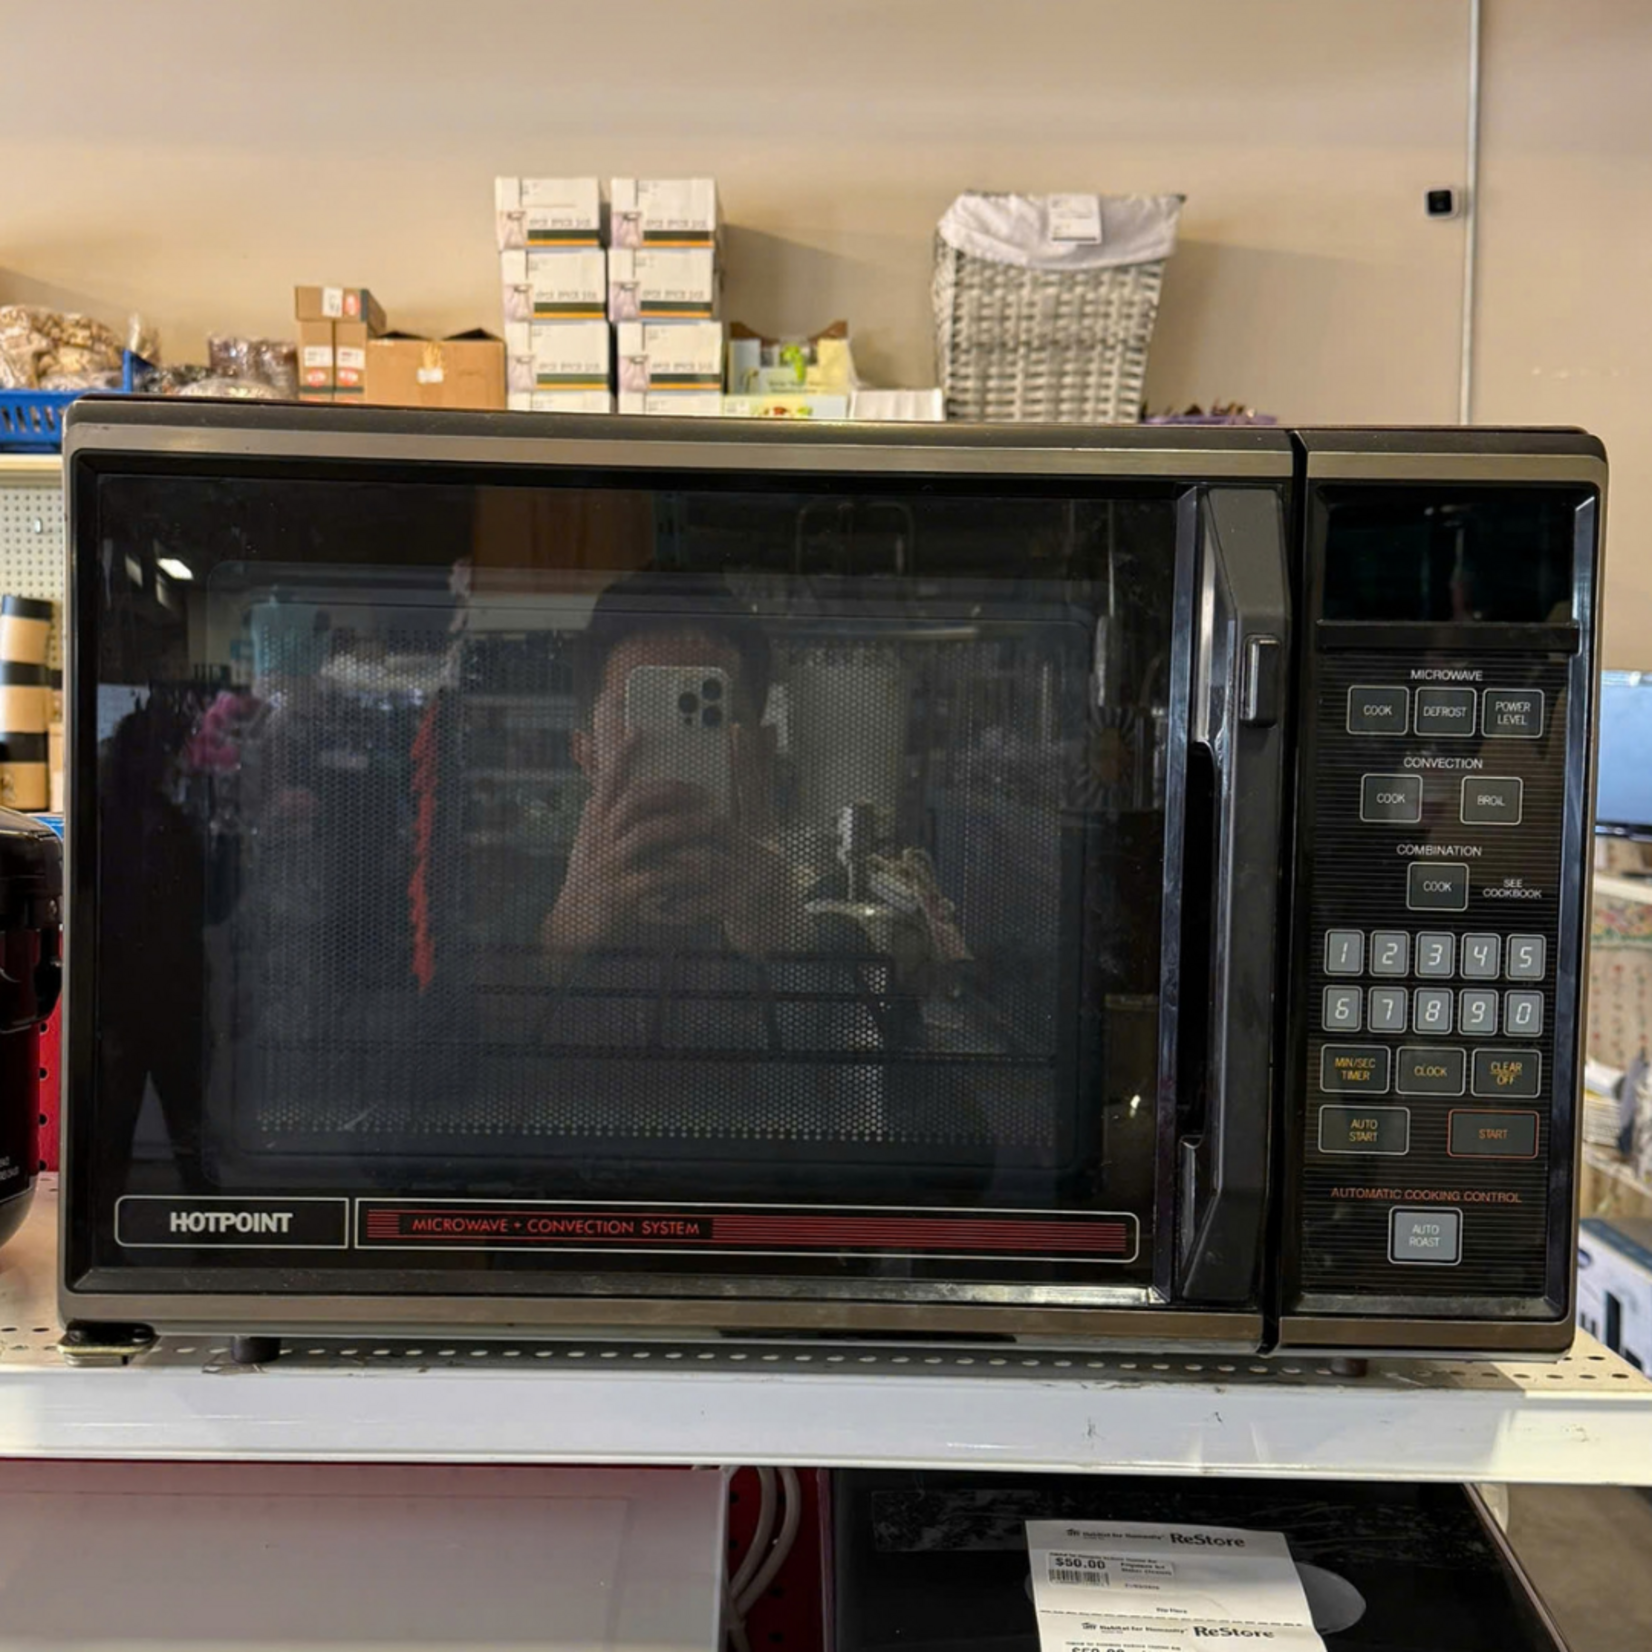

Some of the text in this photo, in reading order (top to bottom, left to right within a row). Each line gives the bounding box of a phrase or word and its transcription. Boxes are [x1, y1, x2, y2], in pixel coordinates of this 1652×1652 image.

[1410, 669, 1483, 682] MICROWAVE
[1363, 704, 1392, 716] COOK
[1423, 706, 1467, 718] DEFROST
[1495, 701, 1531, 713] POWER
[1497, 714, 1528, 726] LEVEL
[1403, 757, 1484, 769] CONVECTION
[1376, 793, 1406, 804] COOK
[1476, 795, 1506, 807] BROIL
[1396, 844, 1483, 857] COMBINATION
[1423, 881, 1452, 892] COOK
[1503, 878, 1523, 889] SEE
[1482, 888, 1543, 899] COOKBOOK
[1340, 942, 1533, 968] 1 2 3 4 5
[1334, 998, 1532, 1024] 6 7 8 9 0
[1334, 1057, 1376, 1069] MIN/SEC
[1490, 1061, 1522, 1074] CLEAR
[1341, 1070, 1370, 1081] TIMER
[1414, 1066, 1448, 1077] CLOCK
[1497, 1074, 1514, 1086] OFF
[1351, 1119, 1378, 1130] AUTO
[1349, 1131, 1377, 1142] START
[1478, 1129, 1508, 1140] START
[1331, 1187, 1522, 1204] AUTOMATIC COOKING CONTROL
[169, 1211, 293, 1233] HOTPOINT
[412, 1217, 699, 1235] MICROWAVE CONVECTION SYSTEM
[1411, 1224, 1440, 1235] AUTO
[1408, 1236, 1440, 1247] ROAST
[1169, 1532, 1246, 1548] ReStore
[1055, 1557, 1106, 1570] $50.00
[1193, 1624, 1276, 1639] ReStore
